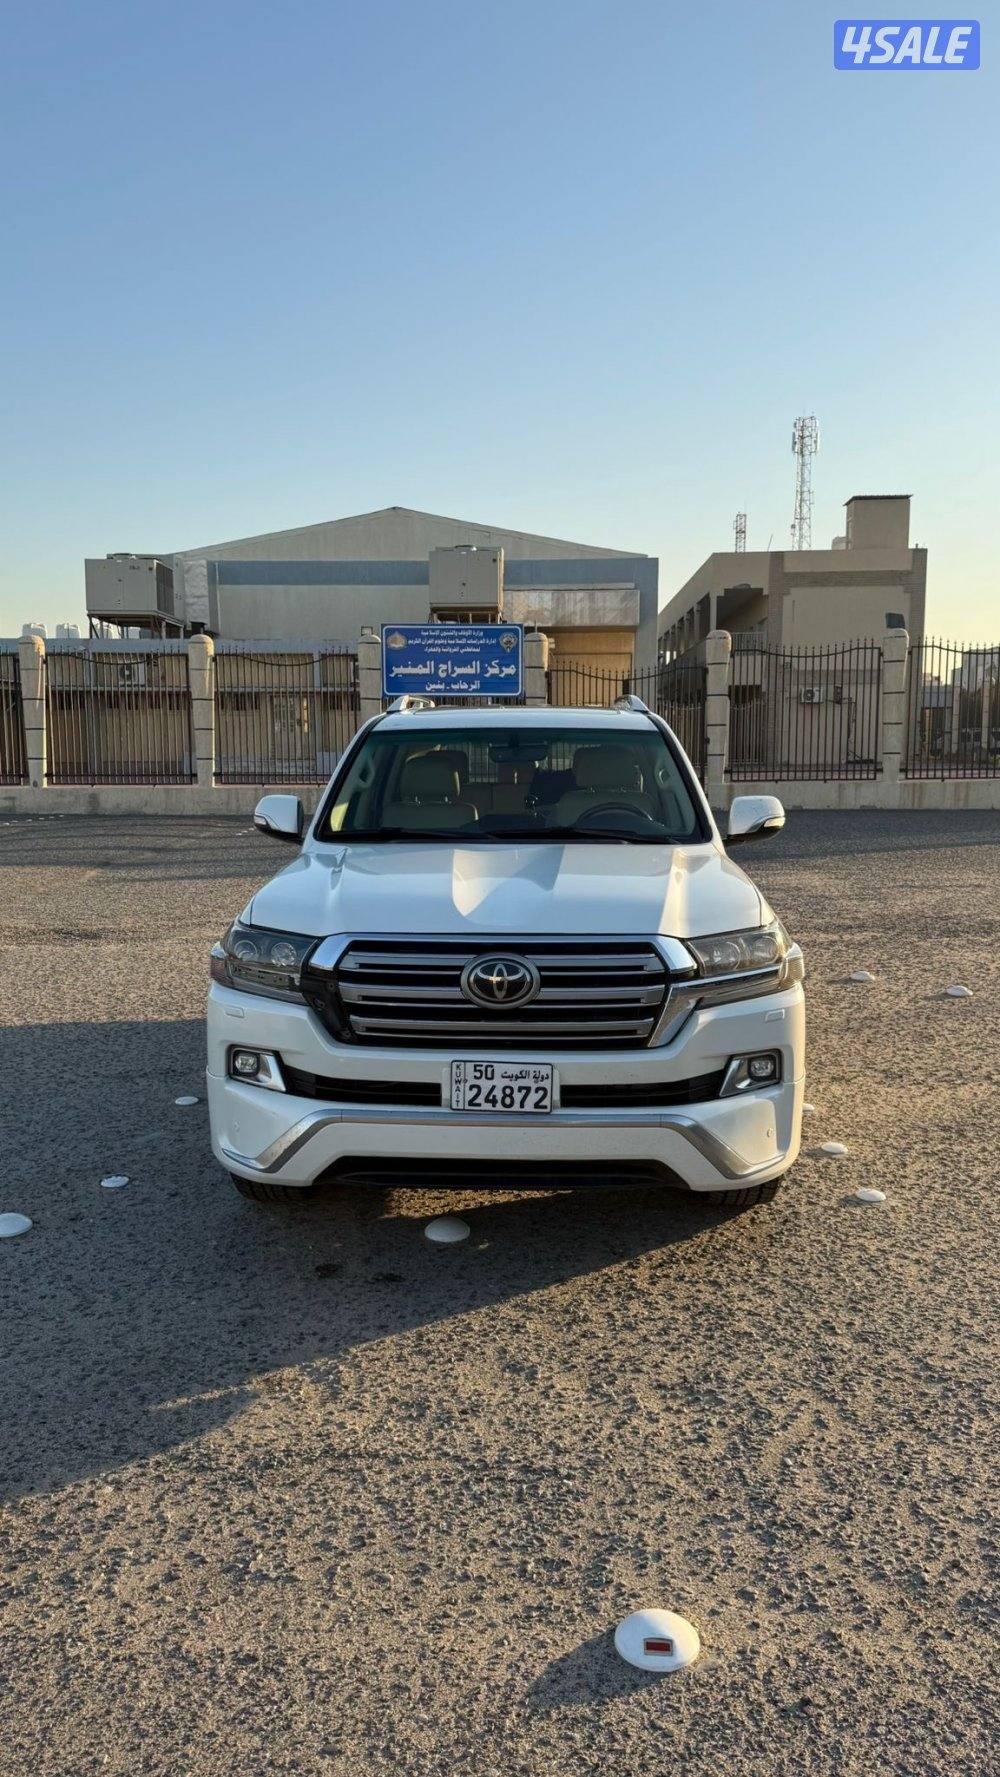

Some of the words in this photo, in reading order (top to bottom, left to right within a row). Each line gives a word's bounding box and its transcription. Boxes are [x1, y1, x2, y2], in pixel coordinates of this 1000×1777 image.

[389, 660, 435, 678] المنير
[438, 660, 480, 679] السراج
[484, 660, 517, 678] مركز
[425, 680, 445, 692] بنين
[451, 680, 480, 691] الرهاب
[473, 1063, 495, 1081] 50
[501, 1069, 531, 1082] الكويت
[532, 1070, 550, 1083] دولة
[467, 1084, 549, 1110] 24872
